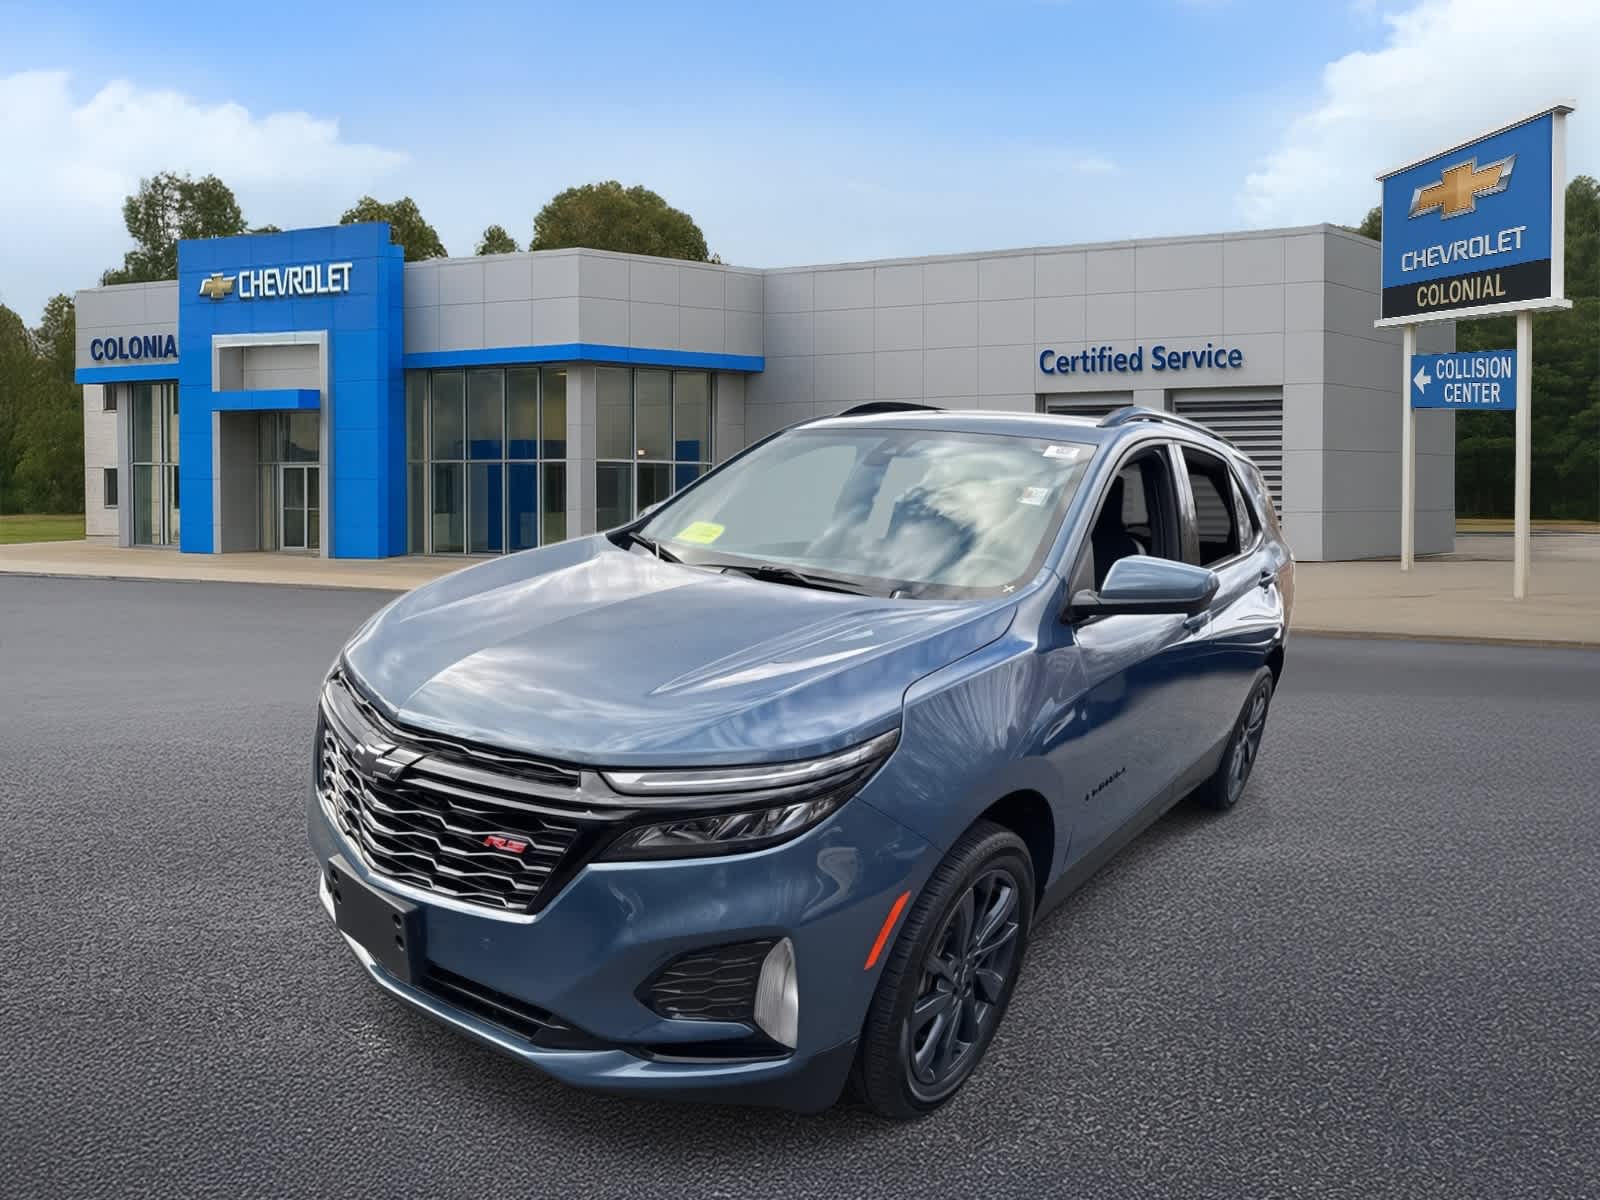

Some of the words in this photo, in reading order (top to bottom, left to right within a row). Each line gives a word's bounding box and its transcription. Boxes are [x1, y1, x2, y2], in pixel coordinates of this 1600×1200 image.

[1401, 225, 1527, 272] CHEVROLET
[239, 262, 352, 298] CHEVROLET
[1416, 273, 1506, 307] COLONIAL
[1039, 346, 1143, 374] Certified
[1151, 343, 1243, 371] Service
[1436, 356, 1511, 379] COLLISION
[1444, 382, 1500, 403] CENTER
[484, 835, 528, 853] RS
